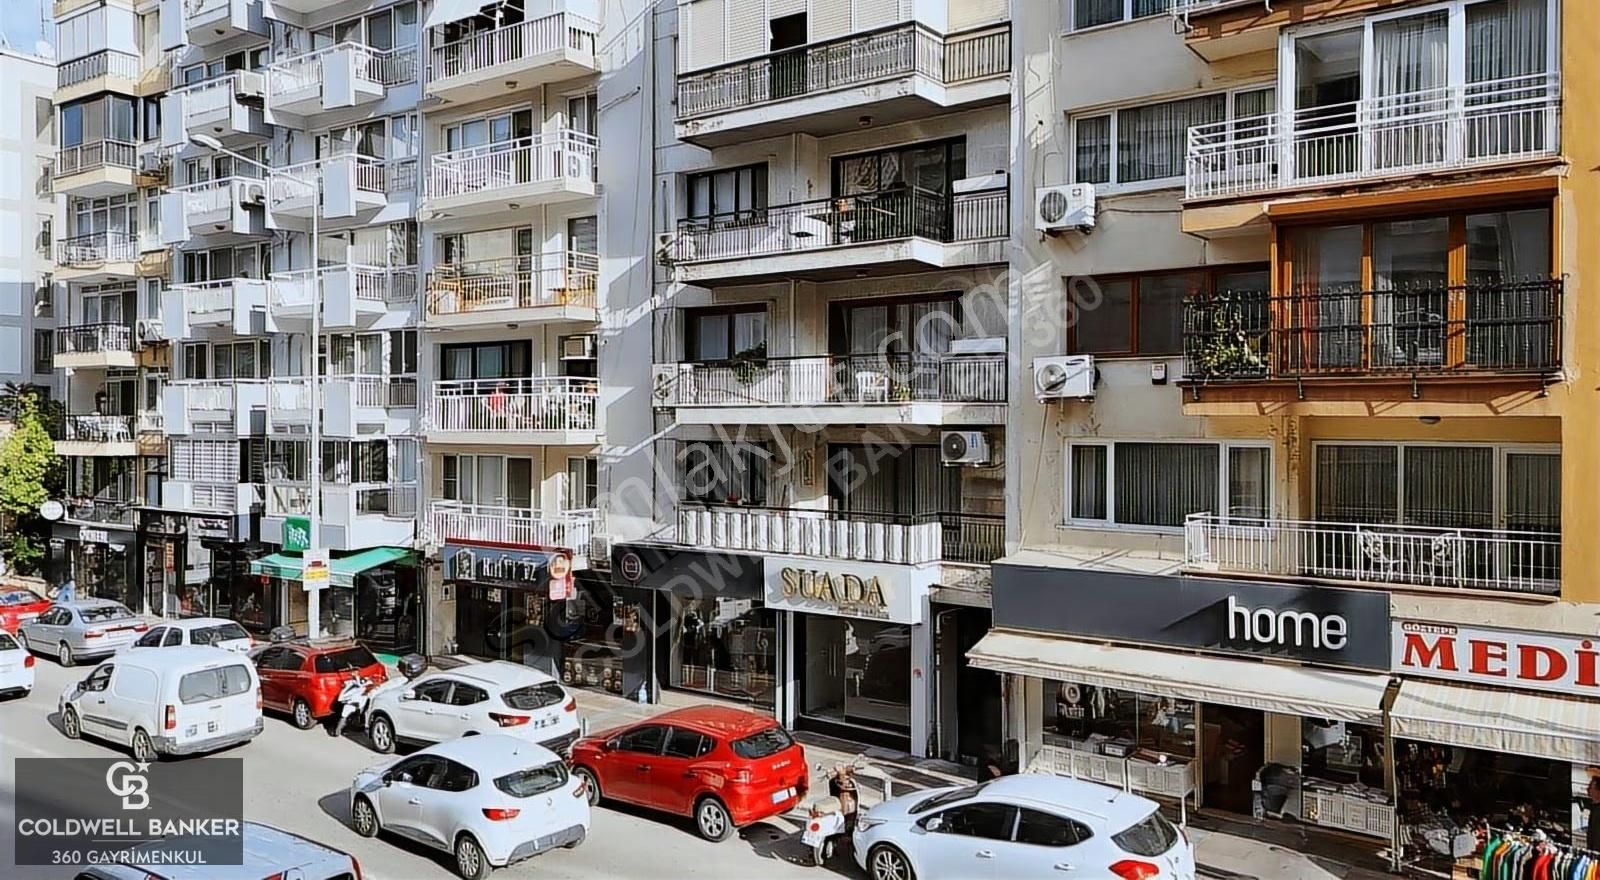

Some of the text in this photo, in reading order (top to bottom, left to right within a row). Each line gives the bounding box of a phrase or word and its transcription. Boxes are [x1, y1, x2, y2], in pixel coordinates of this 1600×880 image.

[780, 566, 888, 607] SUADA
[1228, 595, 1347, 650] home
[1401, 634, 1599, 687] MEDİ
